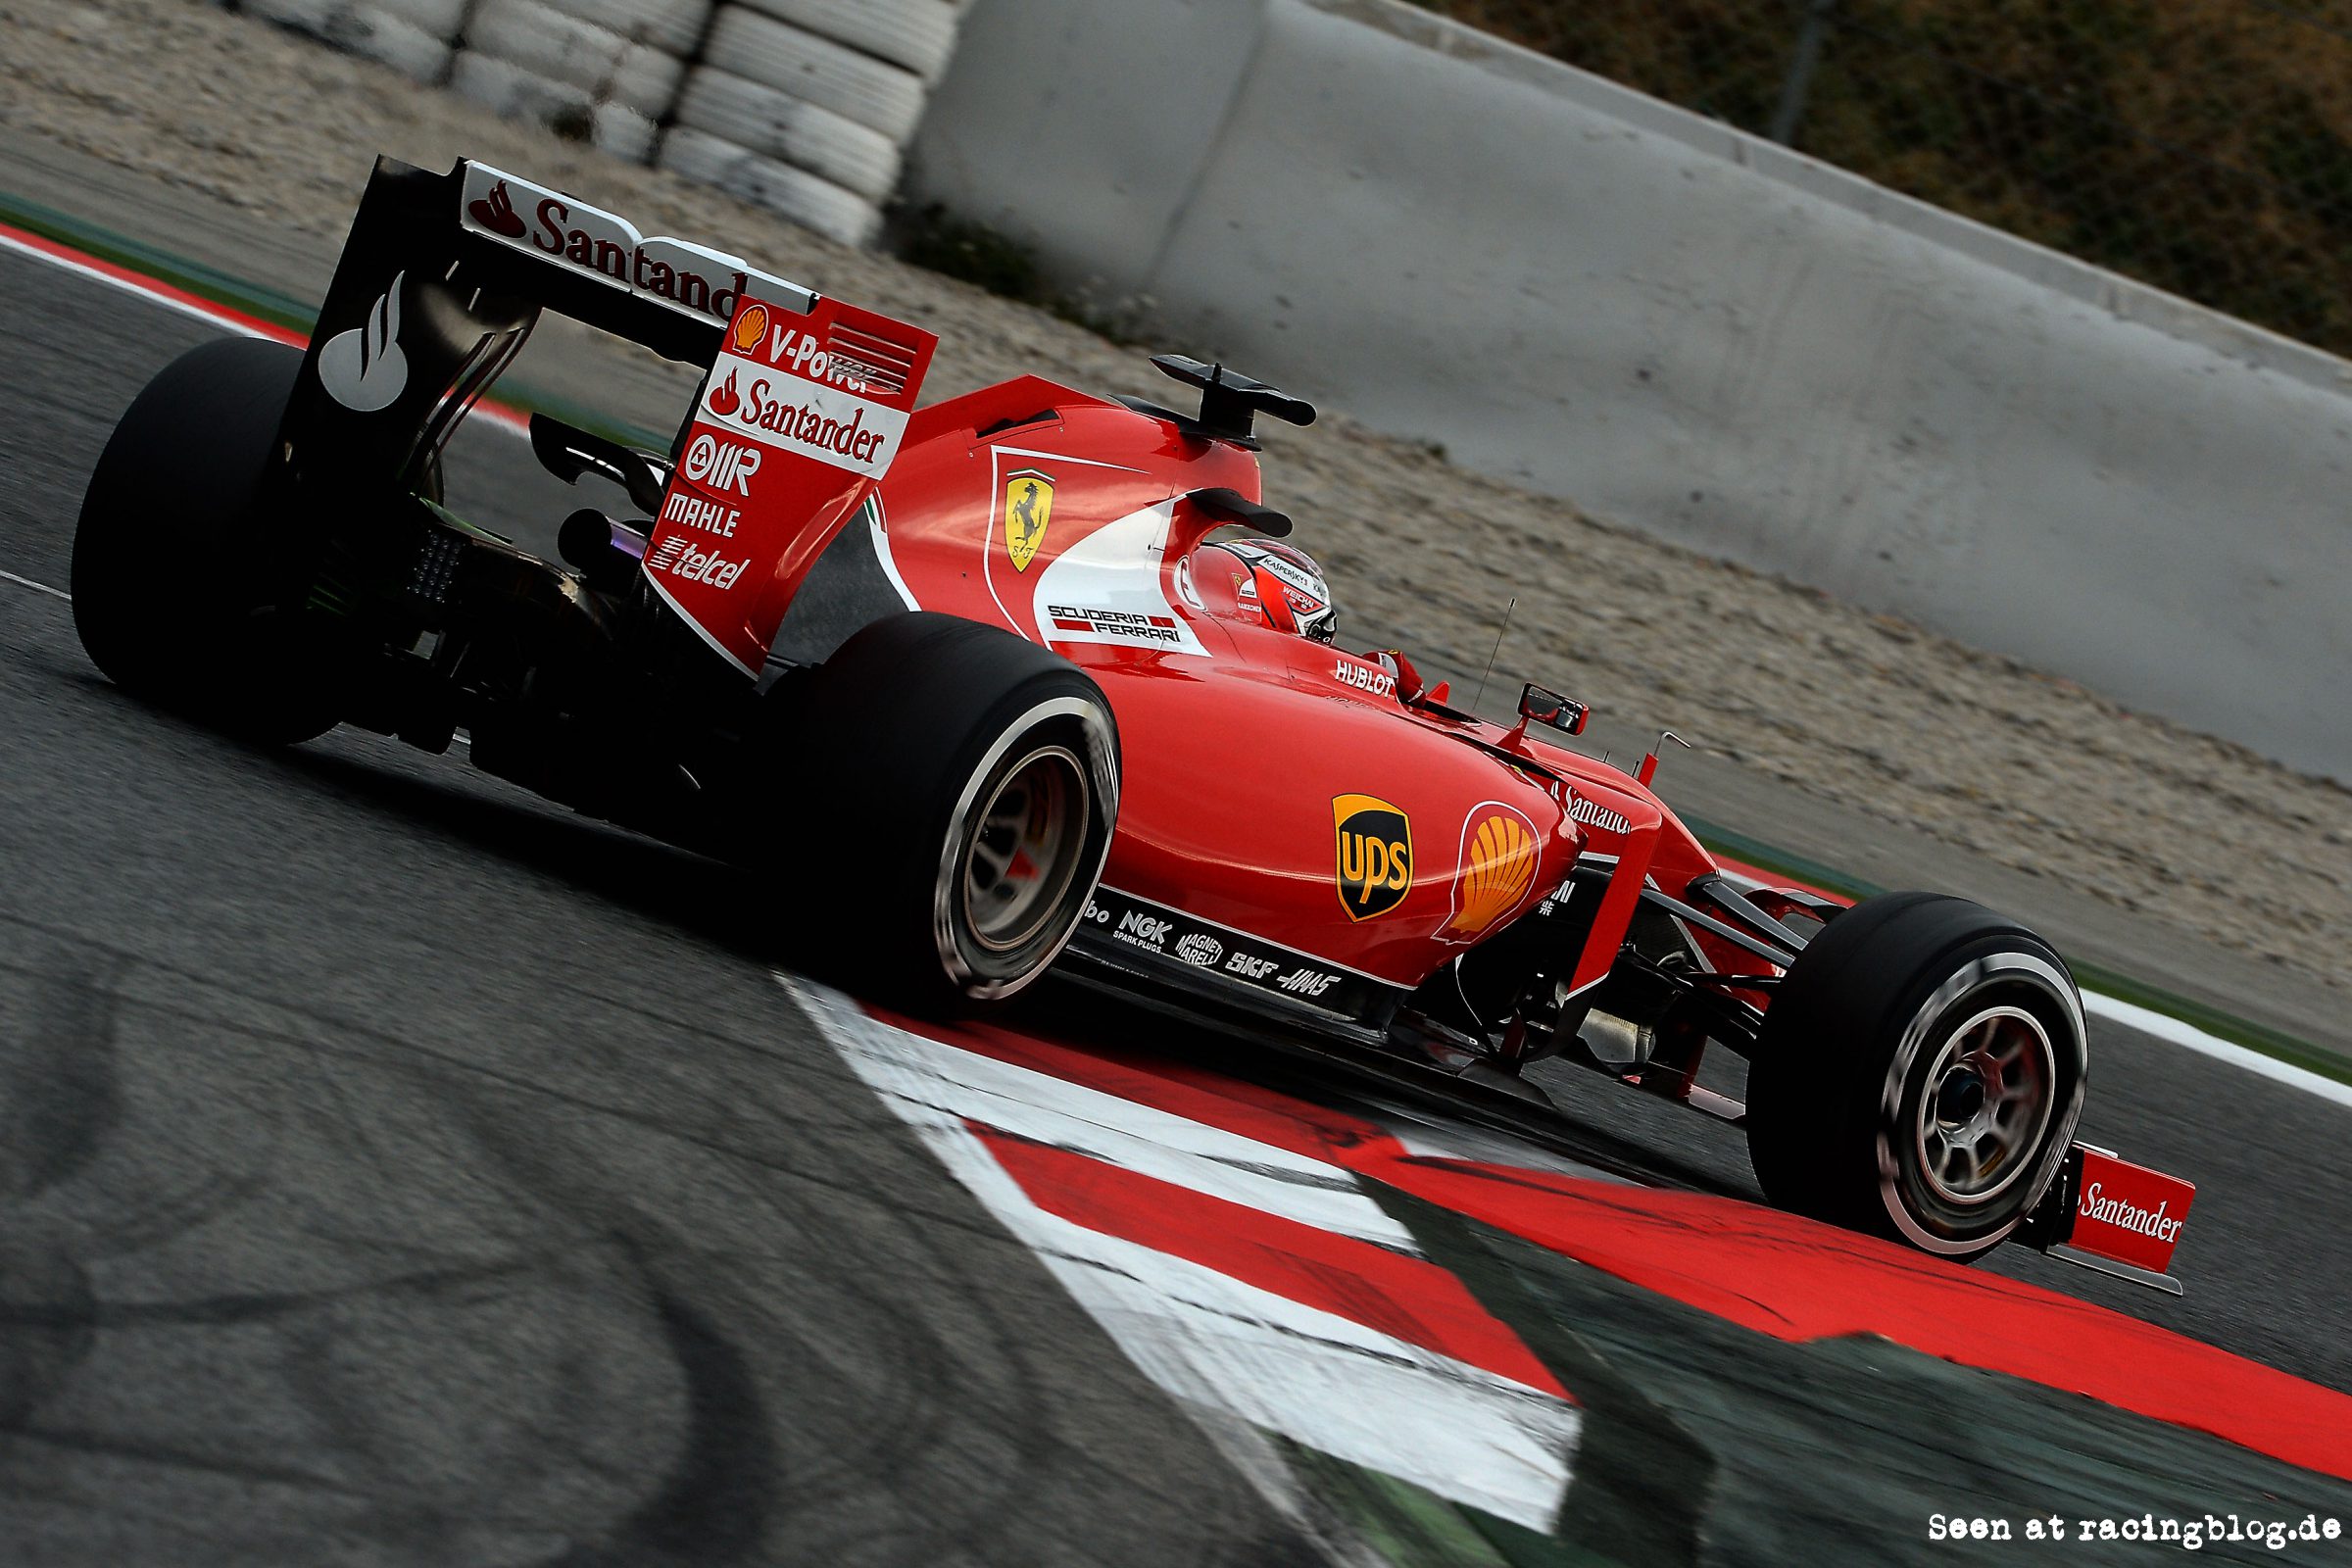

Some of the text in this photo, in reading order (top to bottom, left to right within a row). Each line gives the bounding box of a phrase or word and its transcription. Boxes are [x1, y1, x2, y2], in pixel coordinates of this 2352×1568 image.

[740, 378, 885, 465] Santander
[664, 493, 741, 538] MAHLE
[671, 542, 751, 590] telcel
[1048, 605, 1148, 625] SCUDERIA
[1094, 622, 1181, 643] FERRARI
[1335, 660, 1396, 698] HUBLOT
[1112, 930, 1162, 955] SPARK PLUGS
[1118, 909, 1173, 945] NGK
[1225, 952, 1280, 979] SKF
[1276, 968, 1342, 997] HAAS
[2080, 1182, 2183, 1244] Santander
